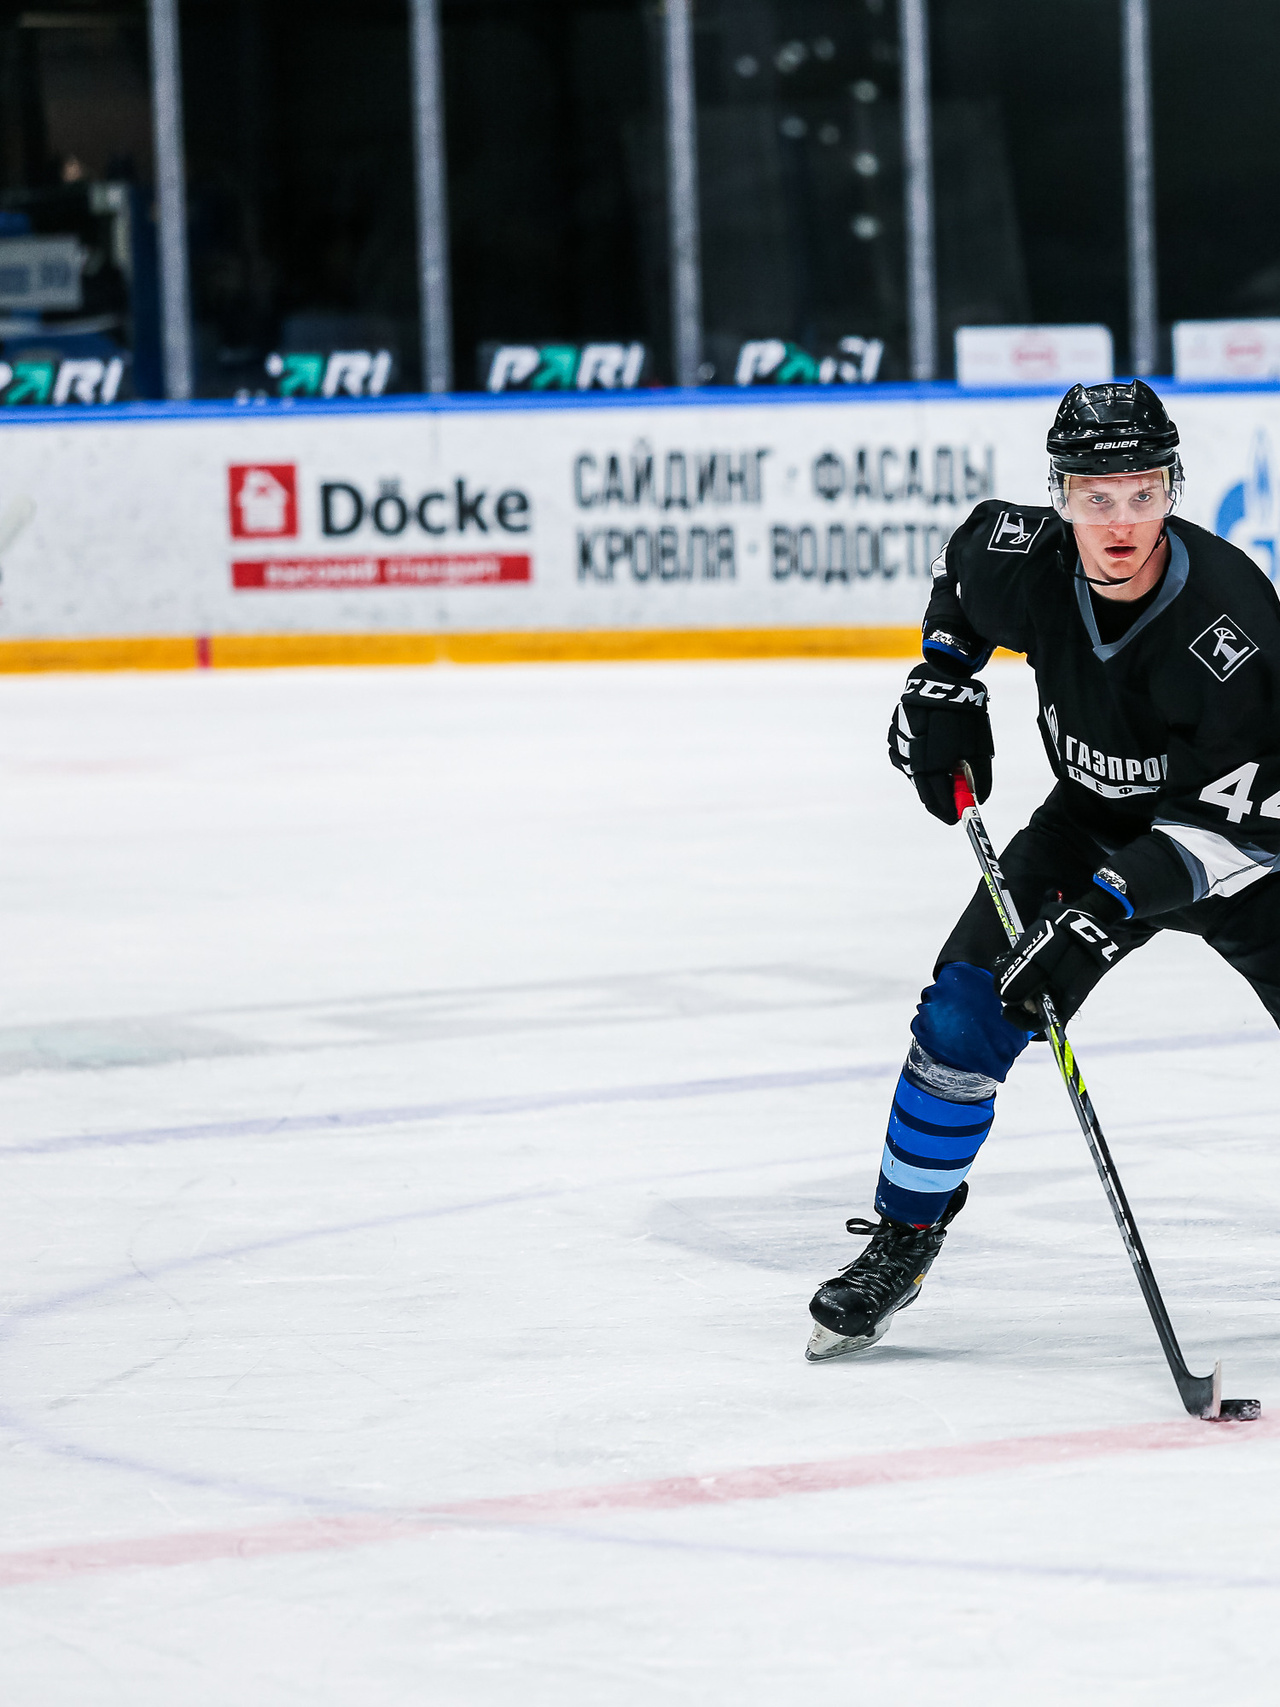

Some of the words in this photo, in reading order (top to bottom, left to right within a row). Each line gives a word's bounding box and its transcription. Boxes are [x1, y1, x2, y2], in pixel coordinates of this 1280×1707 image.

[264, 349, 392, 399] ARI
[487, 341, 645, 393] PARI
[1093, 439, 1139, 450] BAUER
[572, 440, 769, 510] САЙДИНГ
[812, 443, 995, 505] ФАСАДЫ
[318, 477, 532, 537] Döcke
[576, 525, 737, 582] КРОВЛЯ
[771, 521, 950, 584] ВОДОСТО
[903, 678, 986, 707] CCM
